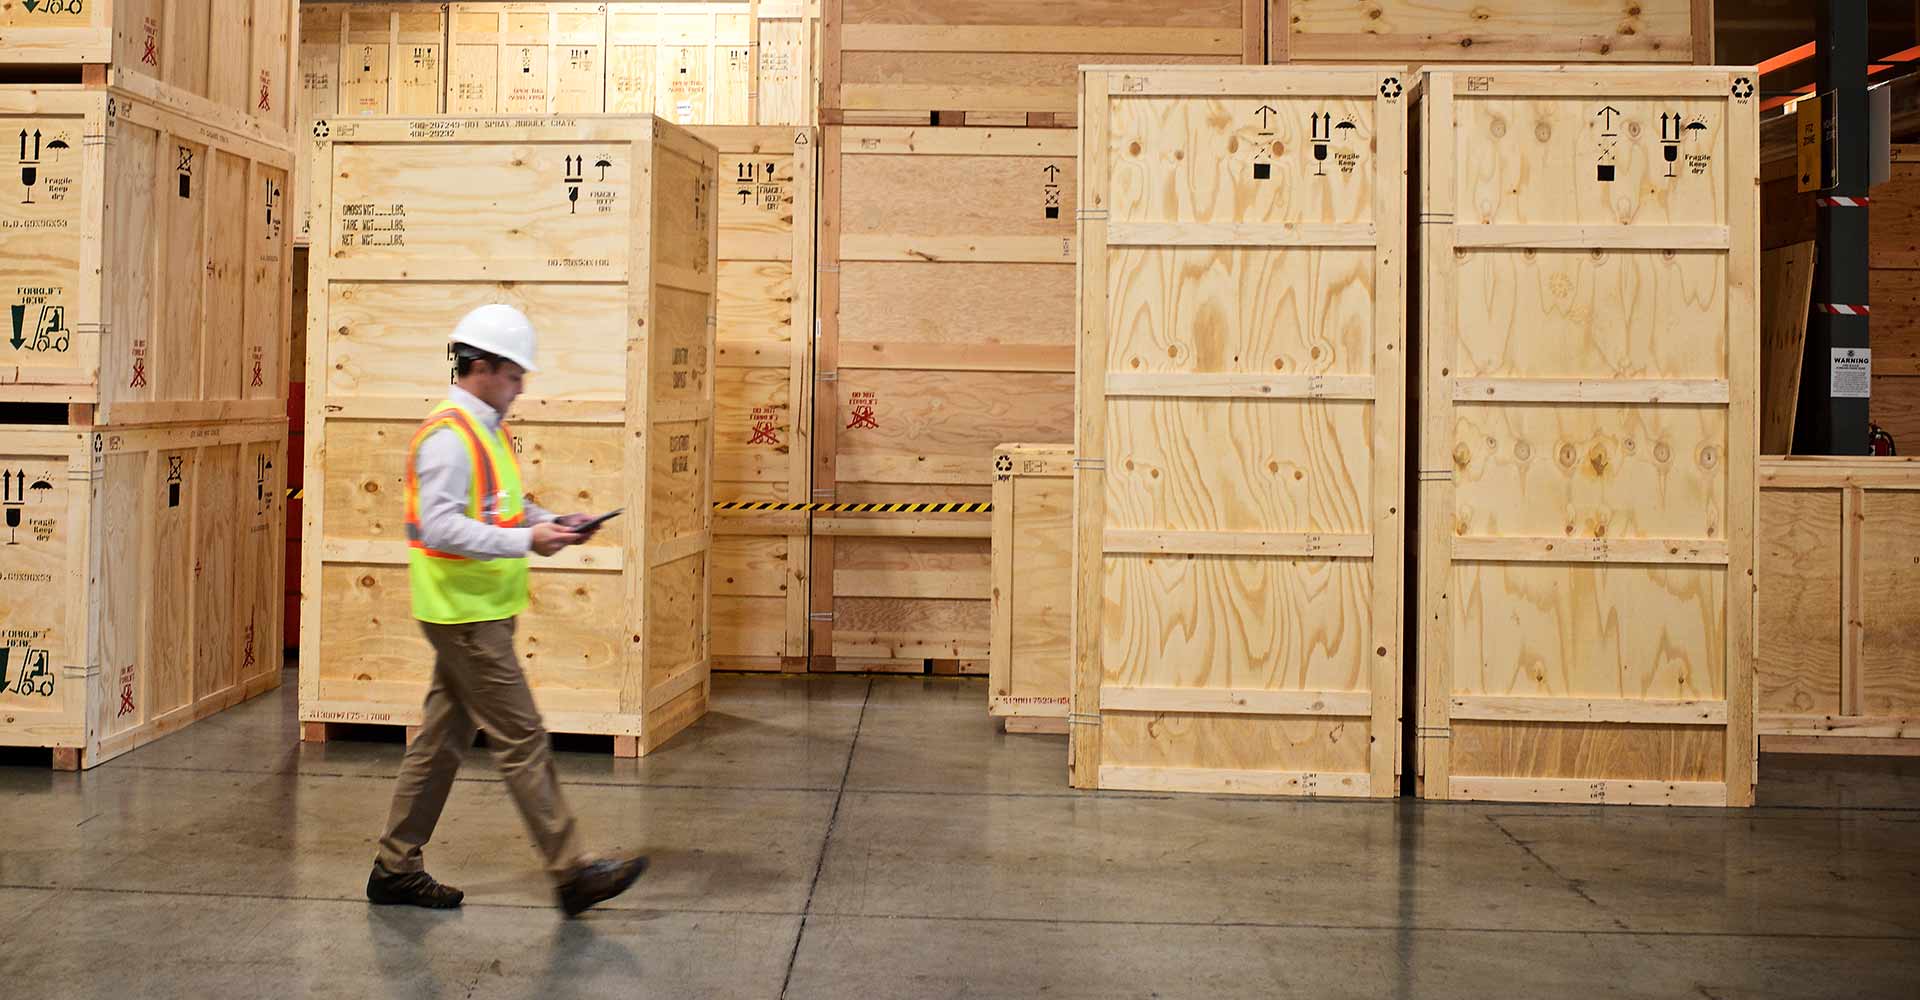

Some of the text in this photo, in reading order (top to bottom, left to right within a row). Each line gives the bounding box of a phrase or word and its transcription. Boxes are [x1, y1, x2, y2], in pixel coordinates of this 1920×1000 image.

[1684, 154, 1711, 162] Fragile
[1688, 161, 1707, 169] Keep
[44, 177, 73, 185] Fragile
